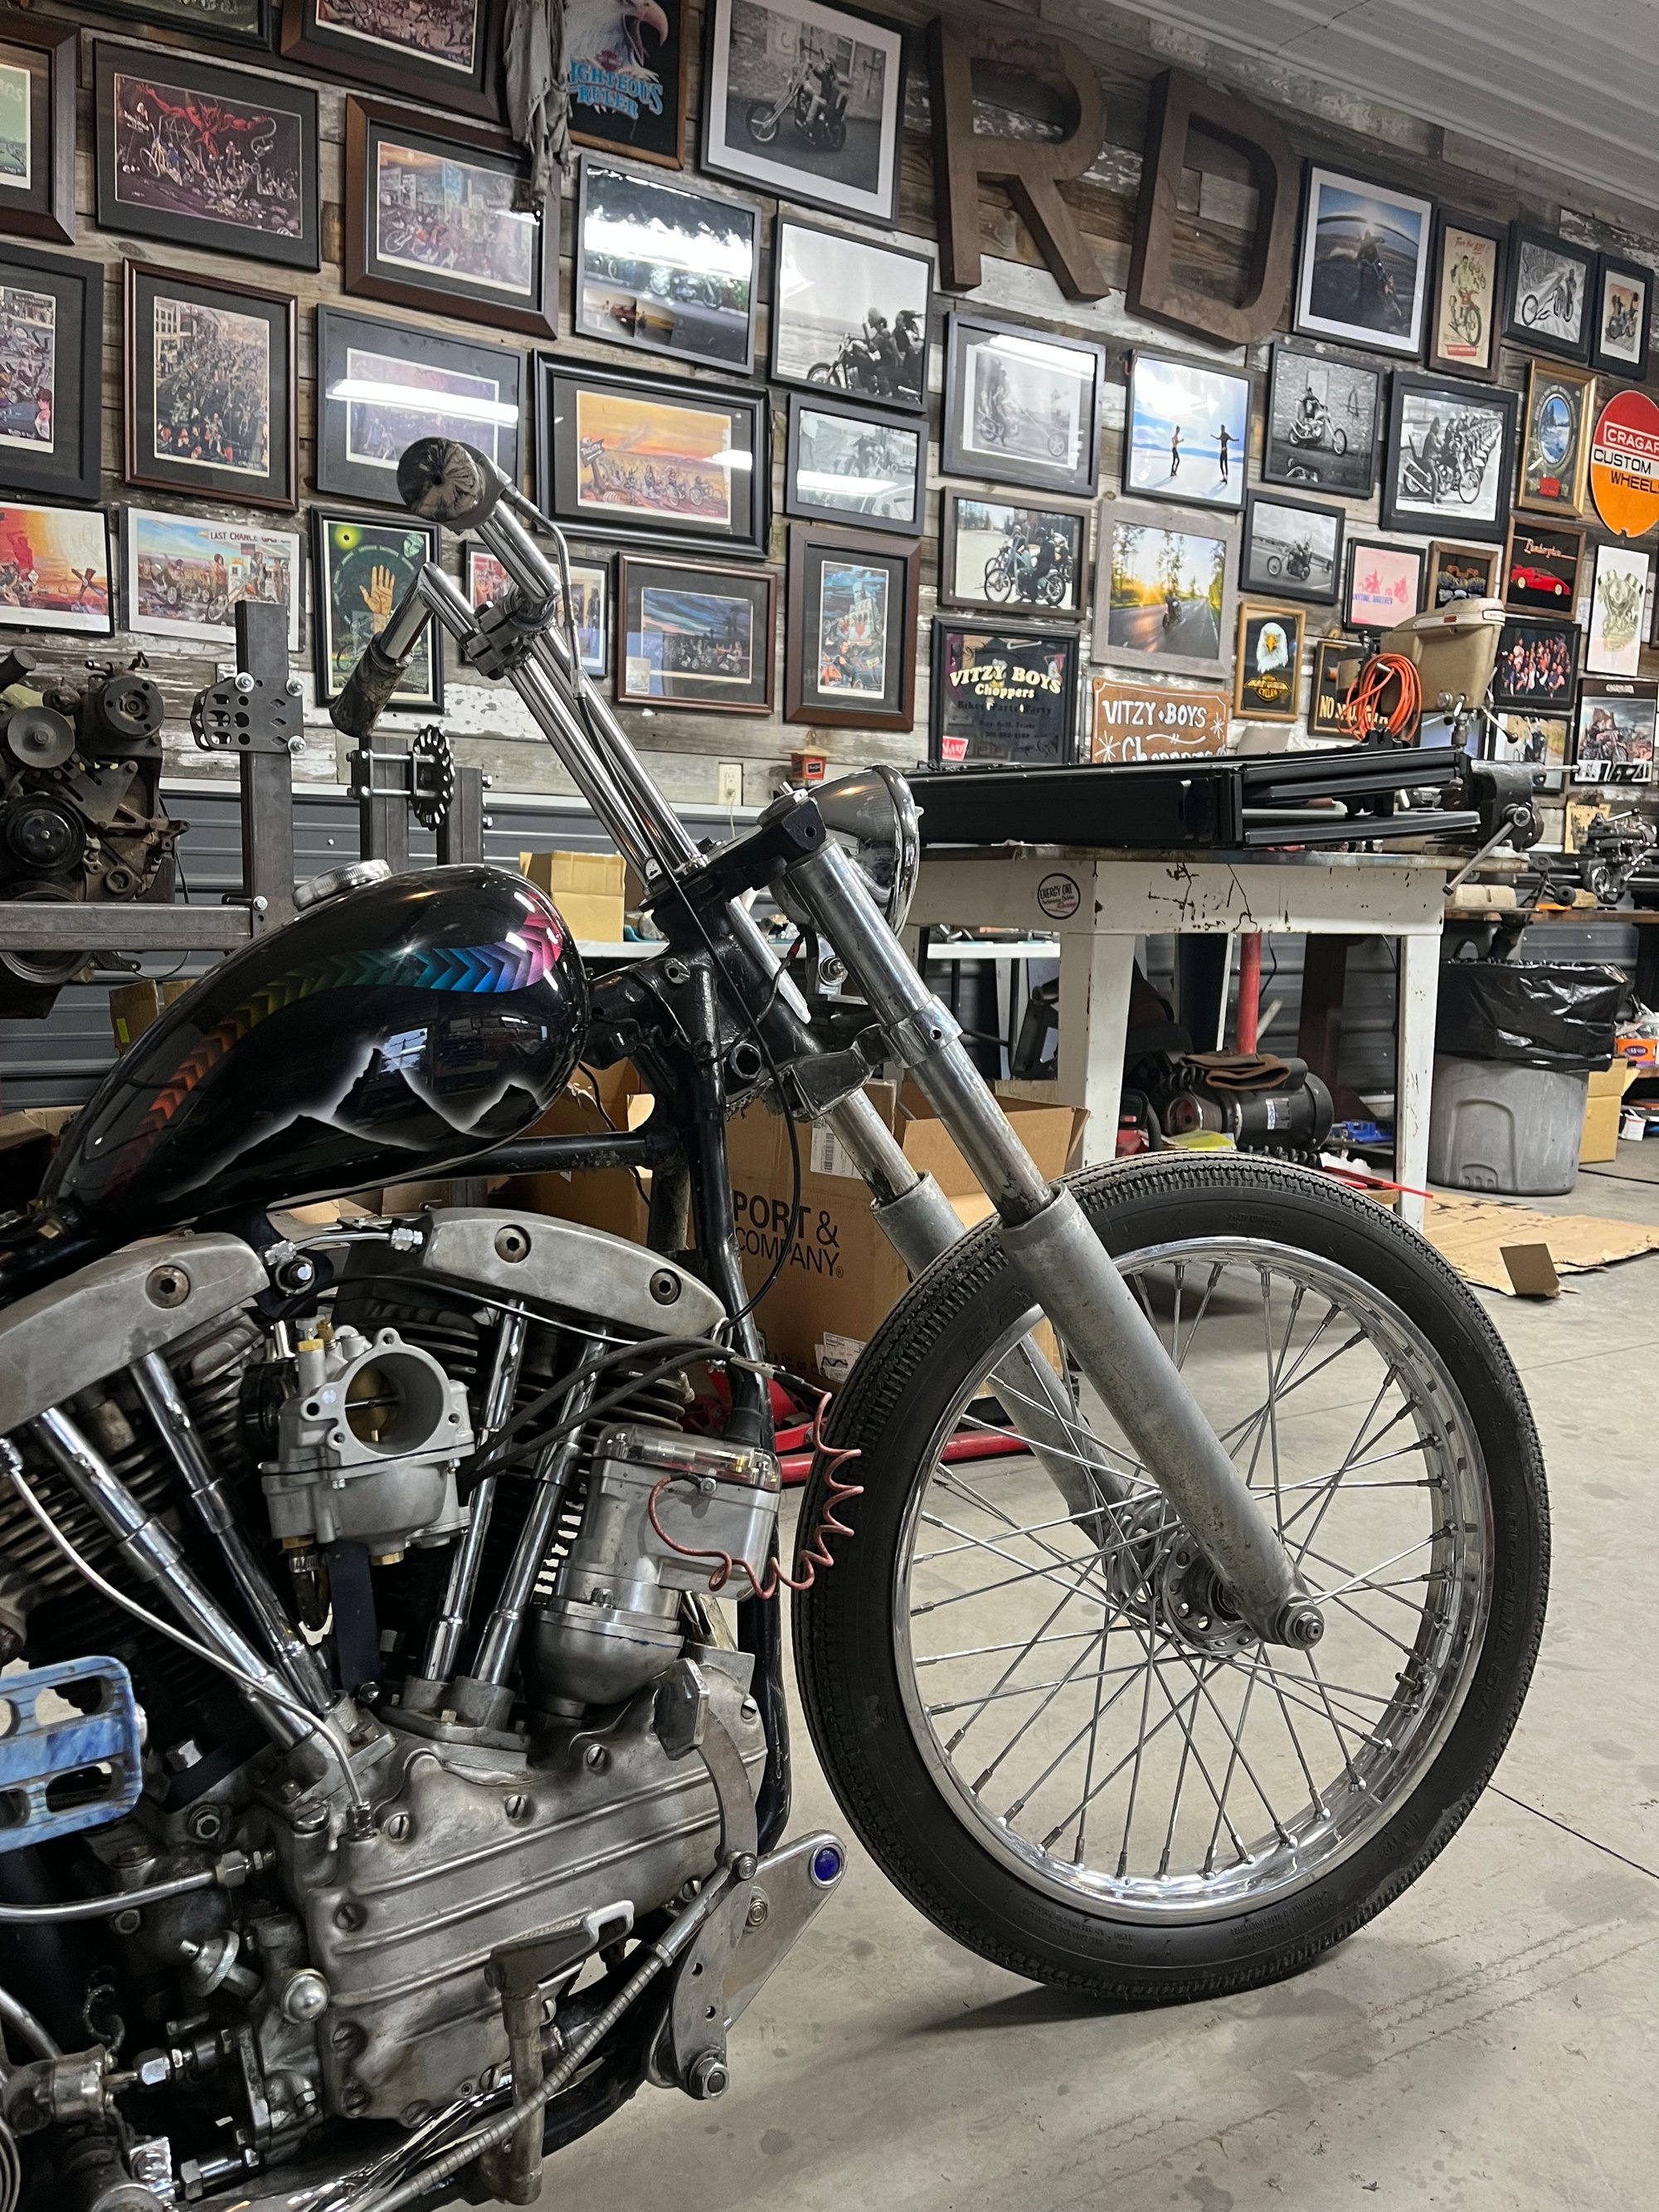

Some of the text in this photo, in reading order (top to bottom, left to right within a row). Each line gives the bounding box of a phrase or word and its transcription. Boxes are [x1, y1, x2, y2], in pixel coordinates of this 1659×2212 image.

[570, 61, 664, 115] IGHTEOUS
[577, 85, 640, 120] RULER
[1593, 448, 1652, 475] CUSTOM
[1611, 470, 1659, 495] WHEEL
[211, 532, 227, 541] LAST
[949, 665, 1062, 694] VITZY BOYS
[974, 683, 1036, 700] Choppers
[1102, 699, 1208, 728] VITZY BOYS
[1320, 695, 1335, 719] NO
[1039, 885, 1062, 900] ENERGY
[1062, 883, 1073, 895] ONE
[732, 1189, 840, 1249] PORT &
